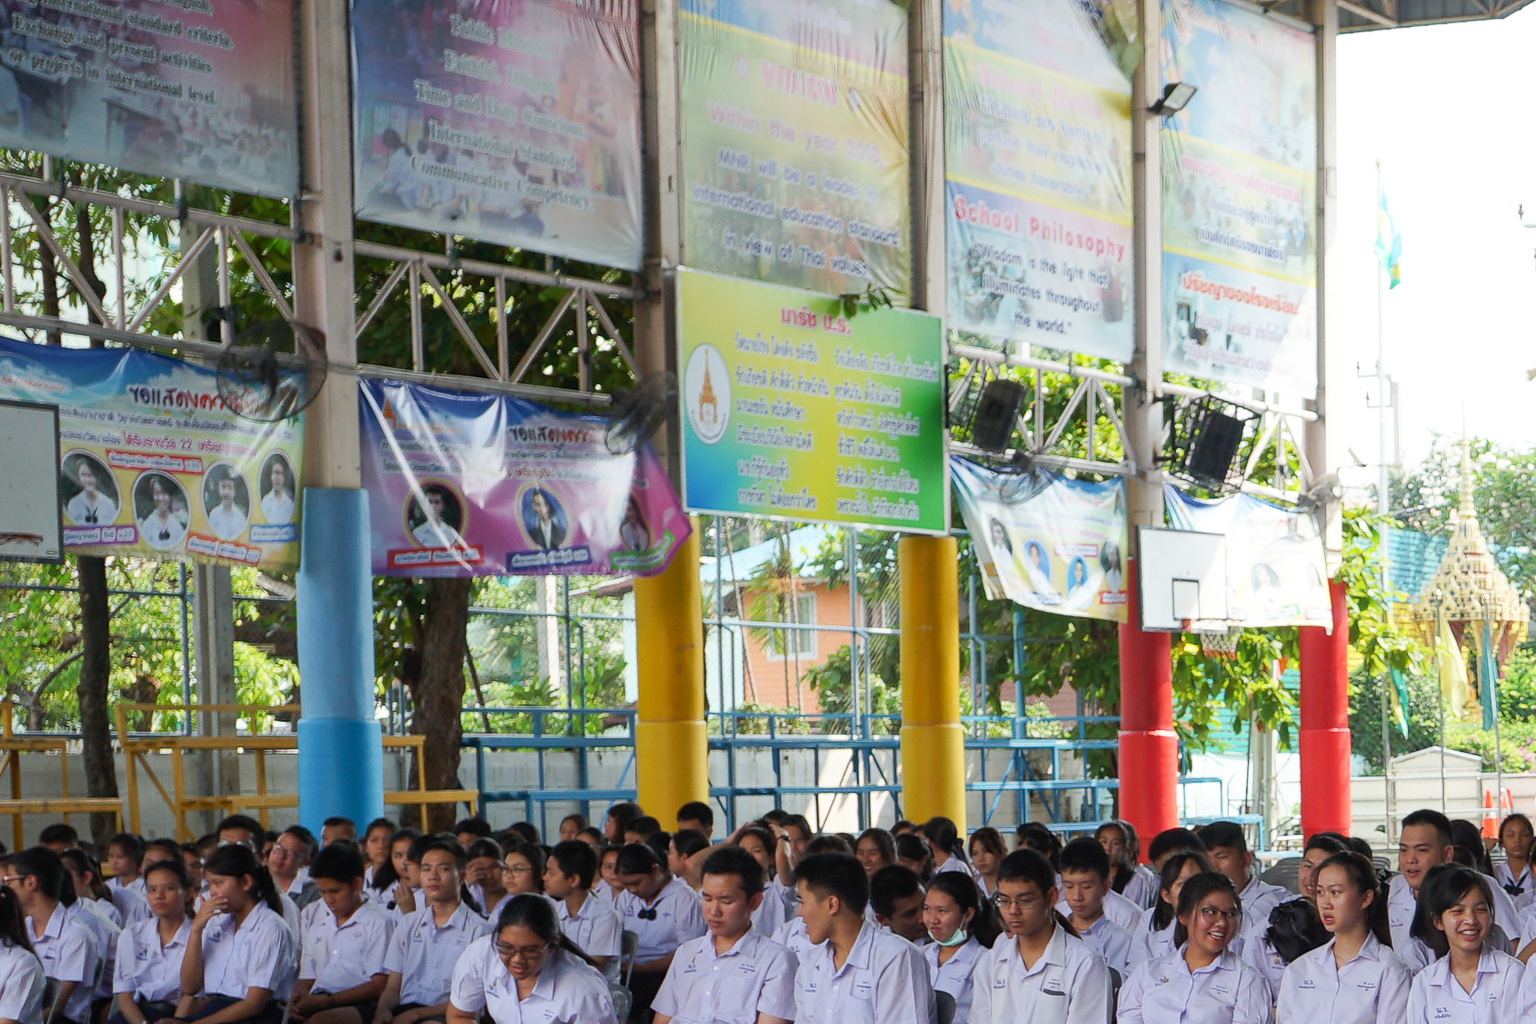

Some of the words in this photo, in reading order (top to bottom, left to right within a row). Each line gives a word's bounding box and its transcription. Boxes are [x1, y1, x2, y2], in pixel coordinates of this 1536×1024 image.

[805, 130, 839, 152] year
[411, 152, 511, 192] Communicative
[756, 159, 778, 177] will
[784, 163, 801, 184] be
[692, 181, 776, 218] international
[781, 204, 843, 233] education
[955, 196, 1019, 232] School
[1030, 214, 1125, 262] Philosophy
[779, 242, 794, 261] of
[1040, 257, 1057, 274] the
[1061, 262, 1084, 283] light
[1046, 289, 1101, 313] throughout
[1182, 272, 1299, 315] ปรัชญาของโรงเรียน
[780, 306, 818, 330] มาร์ช
[1014, 311, 1032, 328] the
[180, 438, 193, 449] 22
